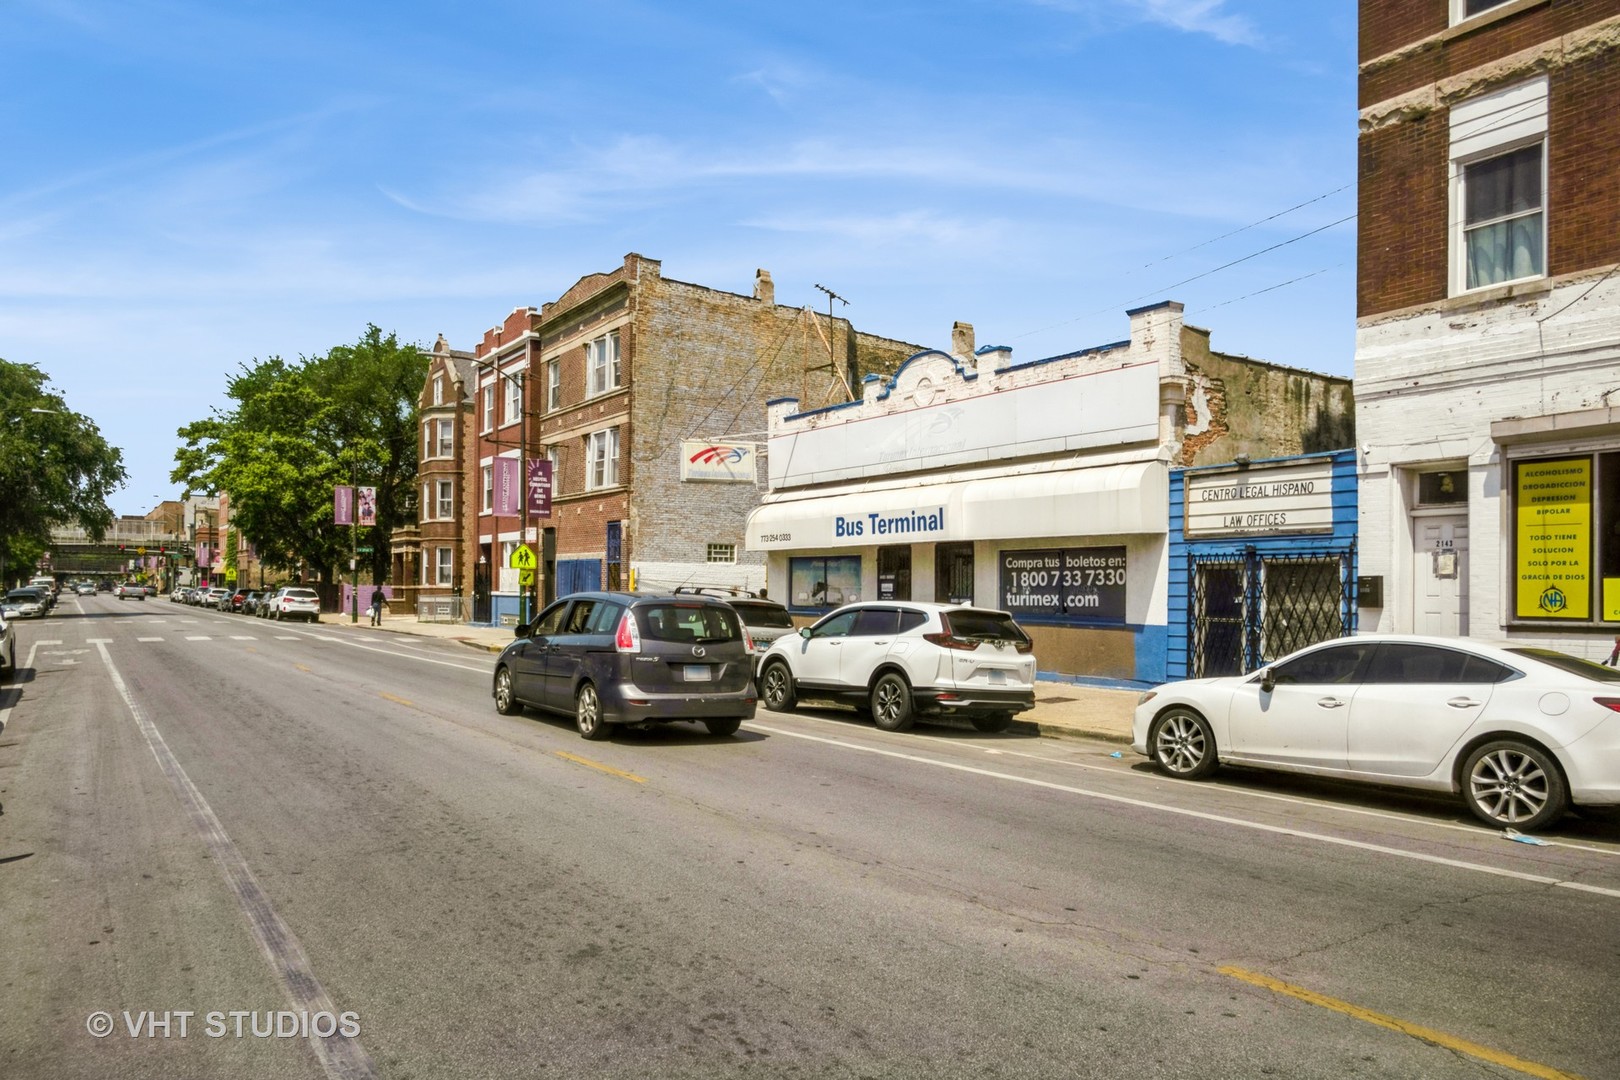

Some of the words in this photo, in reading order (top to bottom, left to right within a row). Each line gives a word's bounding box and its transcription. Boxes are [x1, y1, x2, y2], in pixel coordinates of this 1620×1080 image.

[1525, 468, 1583, 478] ALCOHOLISMO
[1201, 488, 1237, 501] CENTRO
[1240, 486, 1269, 498] LEGAL
[1272, 481, 1314, 497] HISPANO
[1522, 481, 1586, 490] DROGADICCION
[1531, 495, 1576, 503] DEPRESION
[835, 516, 863, 537] Bus
[868, 507, 944, 534] Terminal
[1223, 515, 1243, 528] LAW
[1247, 513, 1286, 526] OFFICES
[1005, 557, 1043, 570] Compra
[1045, 557, 1060, 568] tus
[1066, 556, 1106, 567] boletos
[1108, 557, 1126, 567] en:
[1085, 569, 1126, 586] 7330
